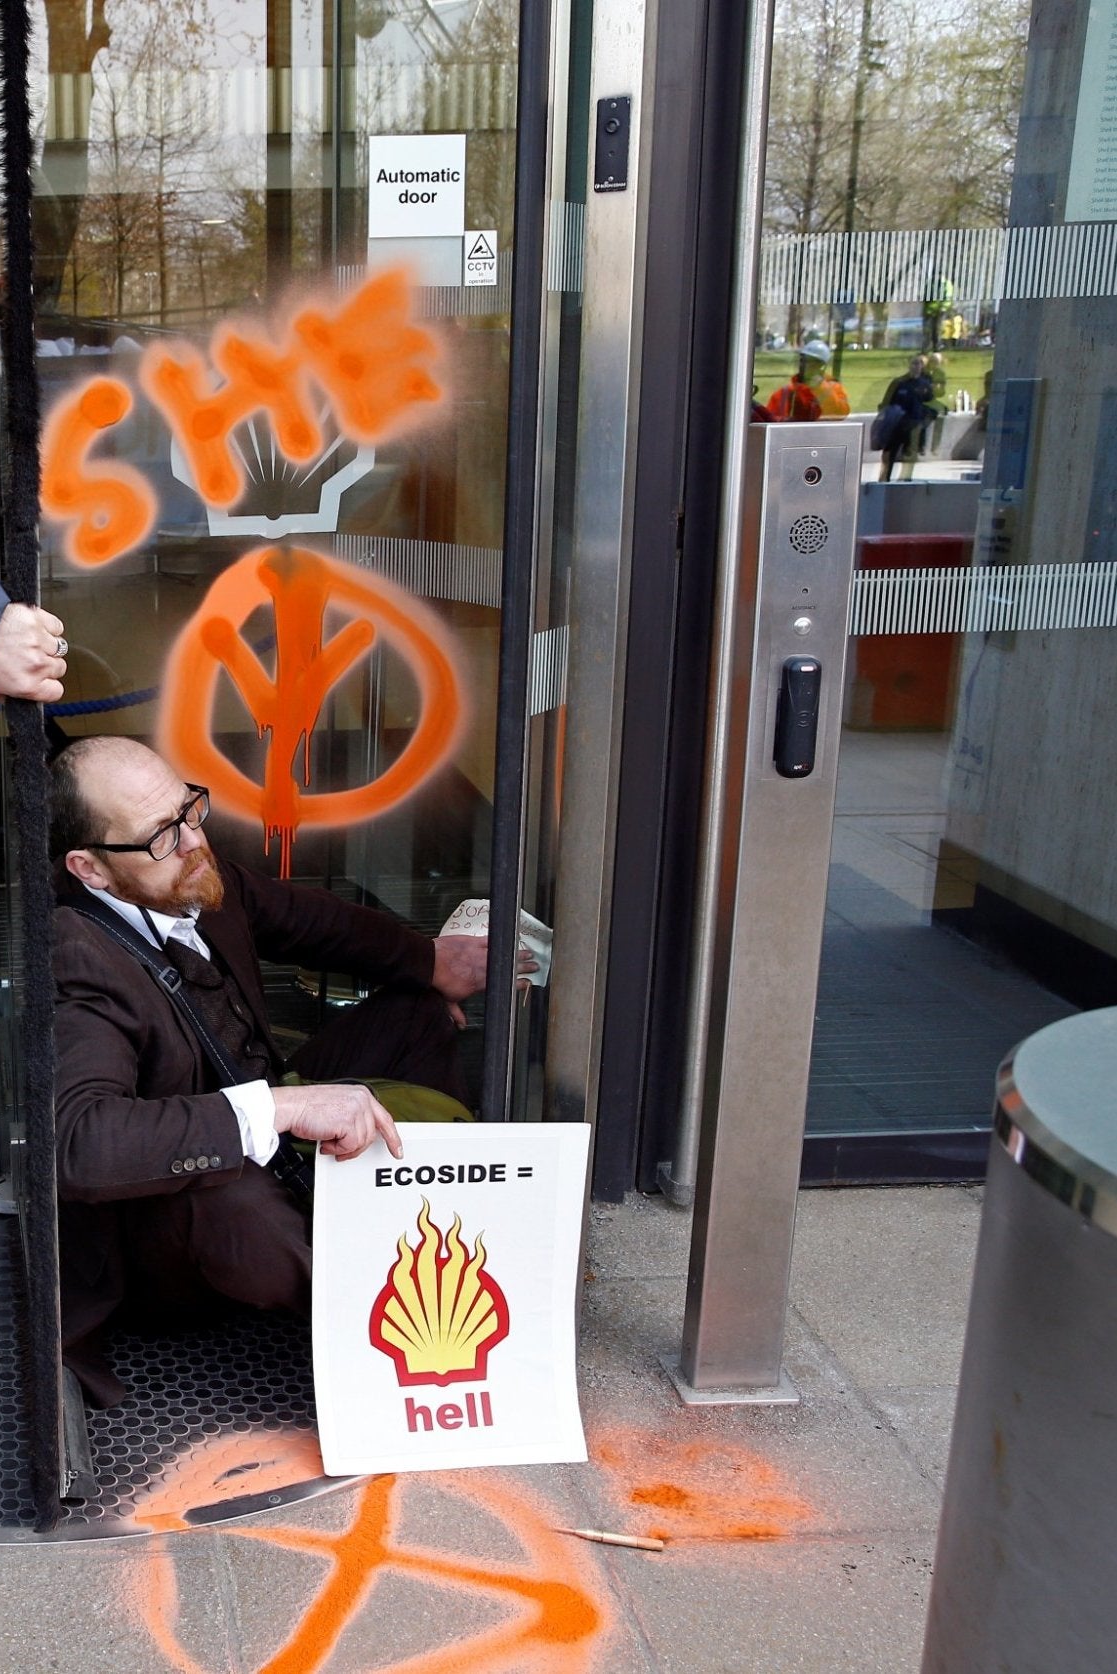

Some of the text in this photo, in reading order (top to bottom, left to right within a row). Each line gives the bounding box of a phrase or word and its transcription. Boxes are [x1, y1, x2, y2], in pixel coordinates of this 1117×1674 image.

[376, 168, 461, 184] Automatic
[398, 190, 438, 204] door
[467, 262, 495, 272] CCTV
[375, 1163, 533, 1187] ECOSIDE =
[404, 1391, 493, 1432] hell
